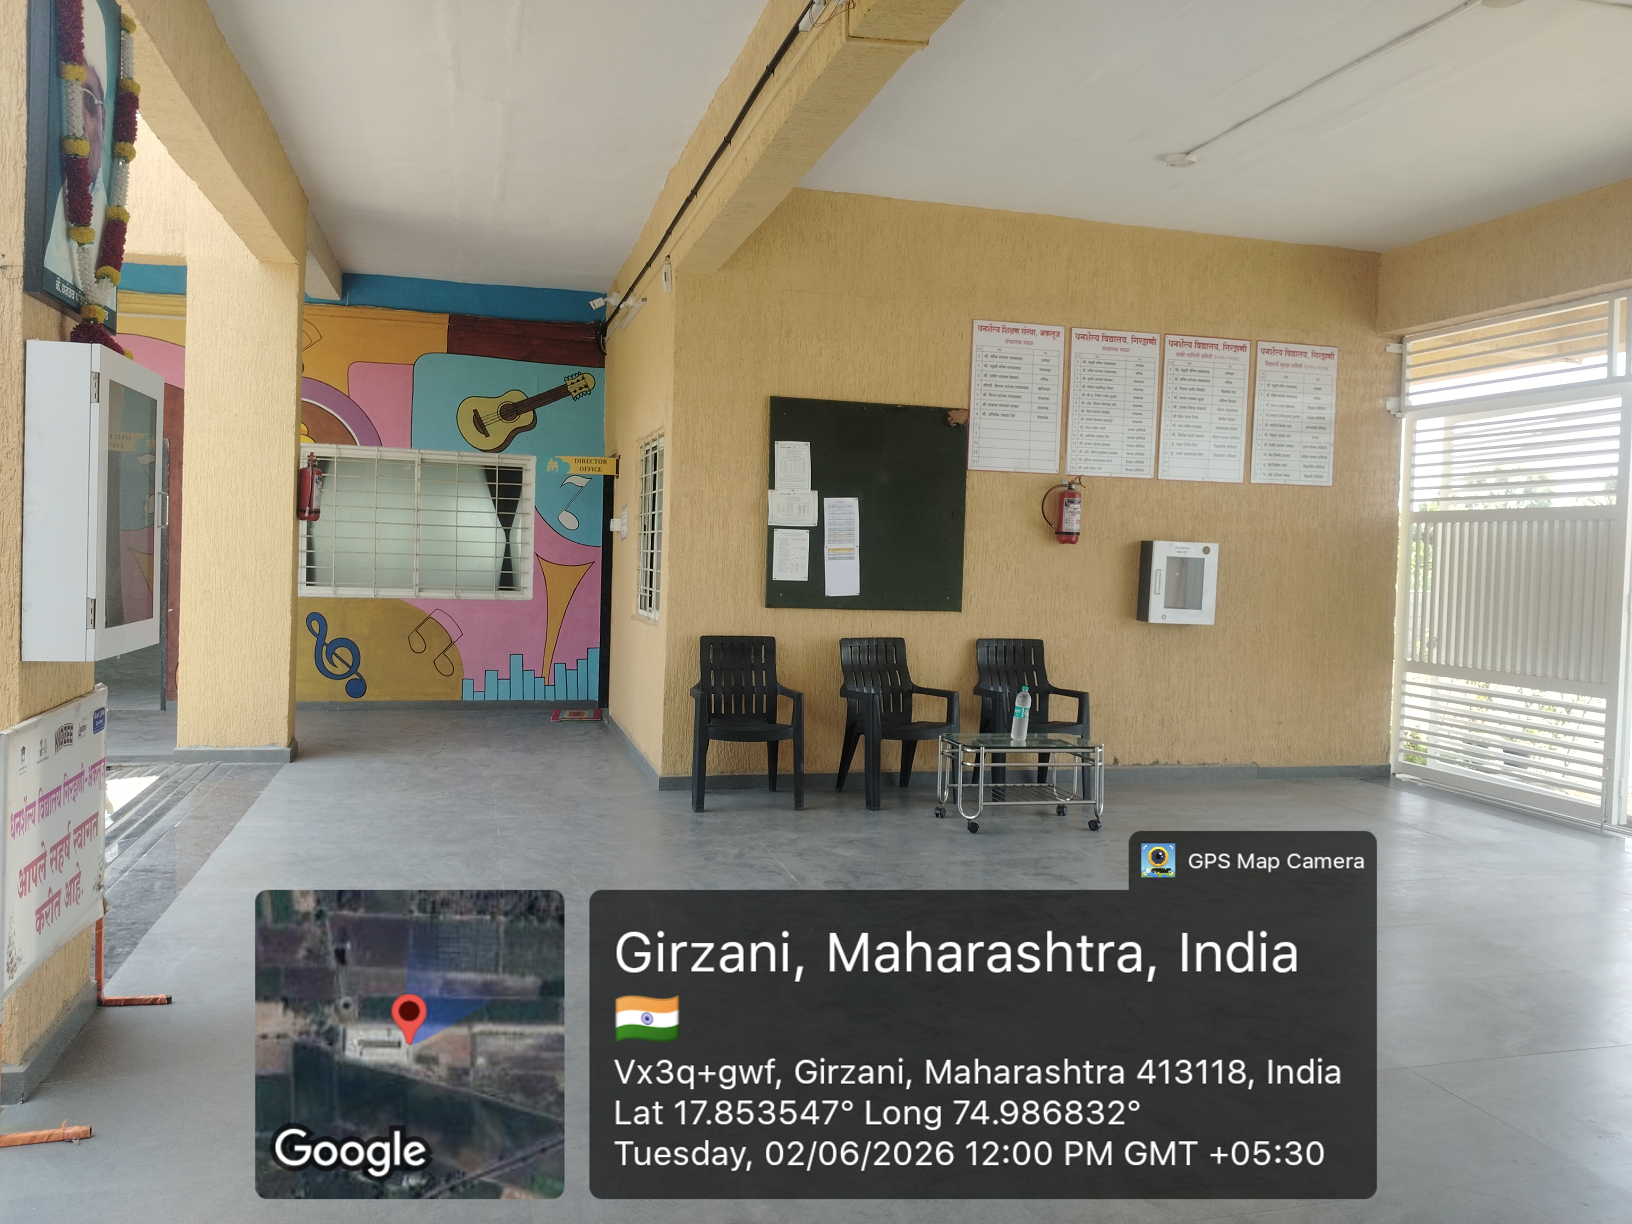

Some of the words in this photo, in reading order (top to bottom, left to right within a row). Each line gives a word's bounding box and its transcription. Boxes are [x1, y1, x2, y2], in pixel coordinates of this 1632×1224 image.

[1002, 325, 1020, 335] शिक्षण
[1021, 326, 1038, 337] संस्था,
[1040, 329, 1060, 340] अकलूज
[1102, 333, 1128, 344] विद्यालय,
[1194, 340, 1220, 351] विद्यालय,
[1285, 347, 1309, 359] विद्यालय,
[38, 787, 62, 823] विद्यालय
[17, 841, 47, 898] आपले
[50, 821, 71, 874] सहर्ष
[73, 811, 99, 854] स्वागत
[35, 887, 62, 935] करीत
[64, 862, 83, 908] आहे.
